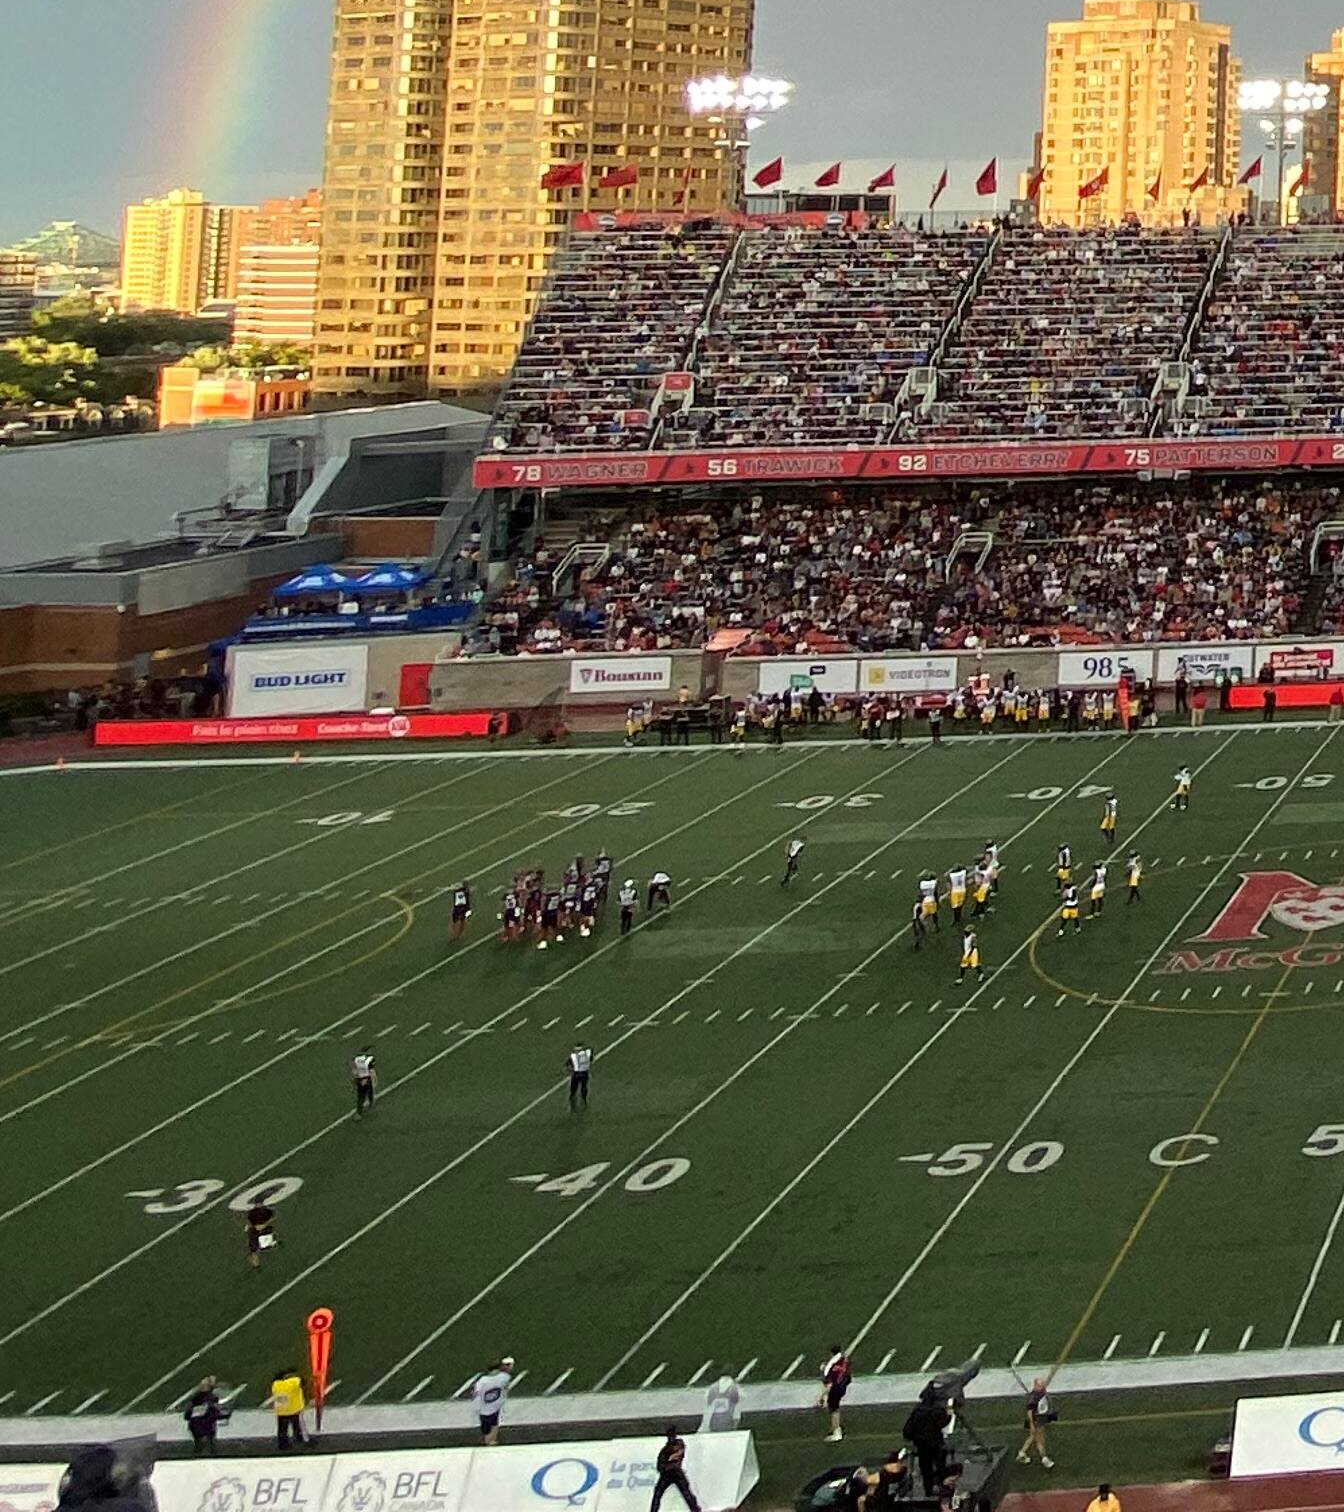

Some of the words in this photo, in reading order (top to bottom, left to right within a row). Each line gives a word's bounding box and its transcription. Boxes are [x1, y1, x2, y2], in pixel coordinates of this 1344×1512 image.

[707, 458, 737, 476] 56
[744, 456, 844, 476] TRAWICK
[1124, 449, 1150, 465] 75
[1154, 445, 1278, 465] PATTERSON
[512, 464, 542, 482] 78
[547, 462, 647, 481] WAGNER
[254, 676, 289, 688] BUD
[295, 672, 346, 686] LIGHT
[926, 1141, 1064, 1178] 50
[1148, 1133, 1220, 1168] C
[534, 1157, 691, 1198] 40
[143, 1176, 305, 1215] 30
[253, 1478, 308, 1504] BFL
[392, 1470, 448, 1499] BFL
